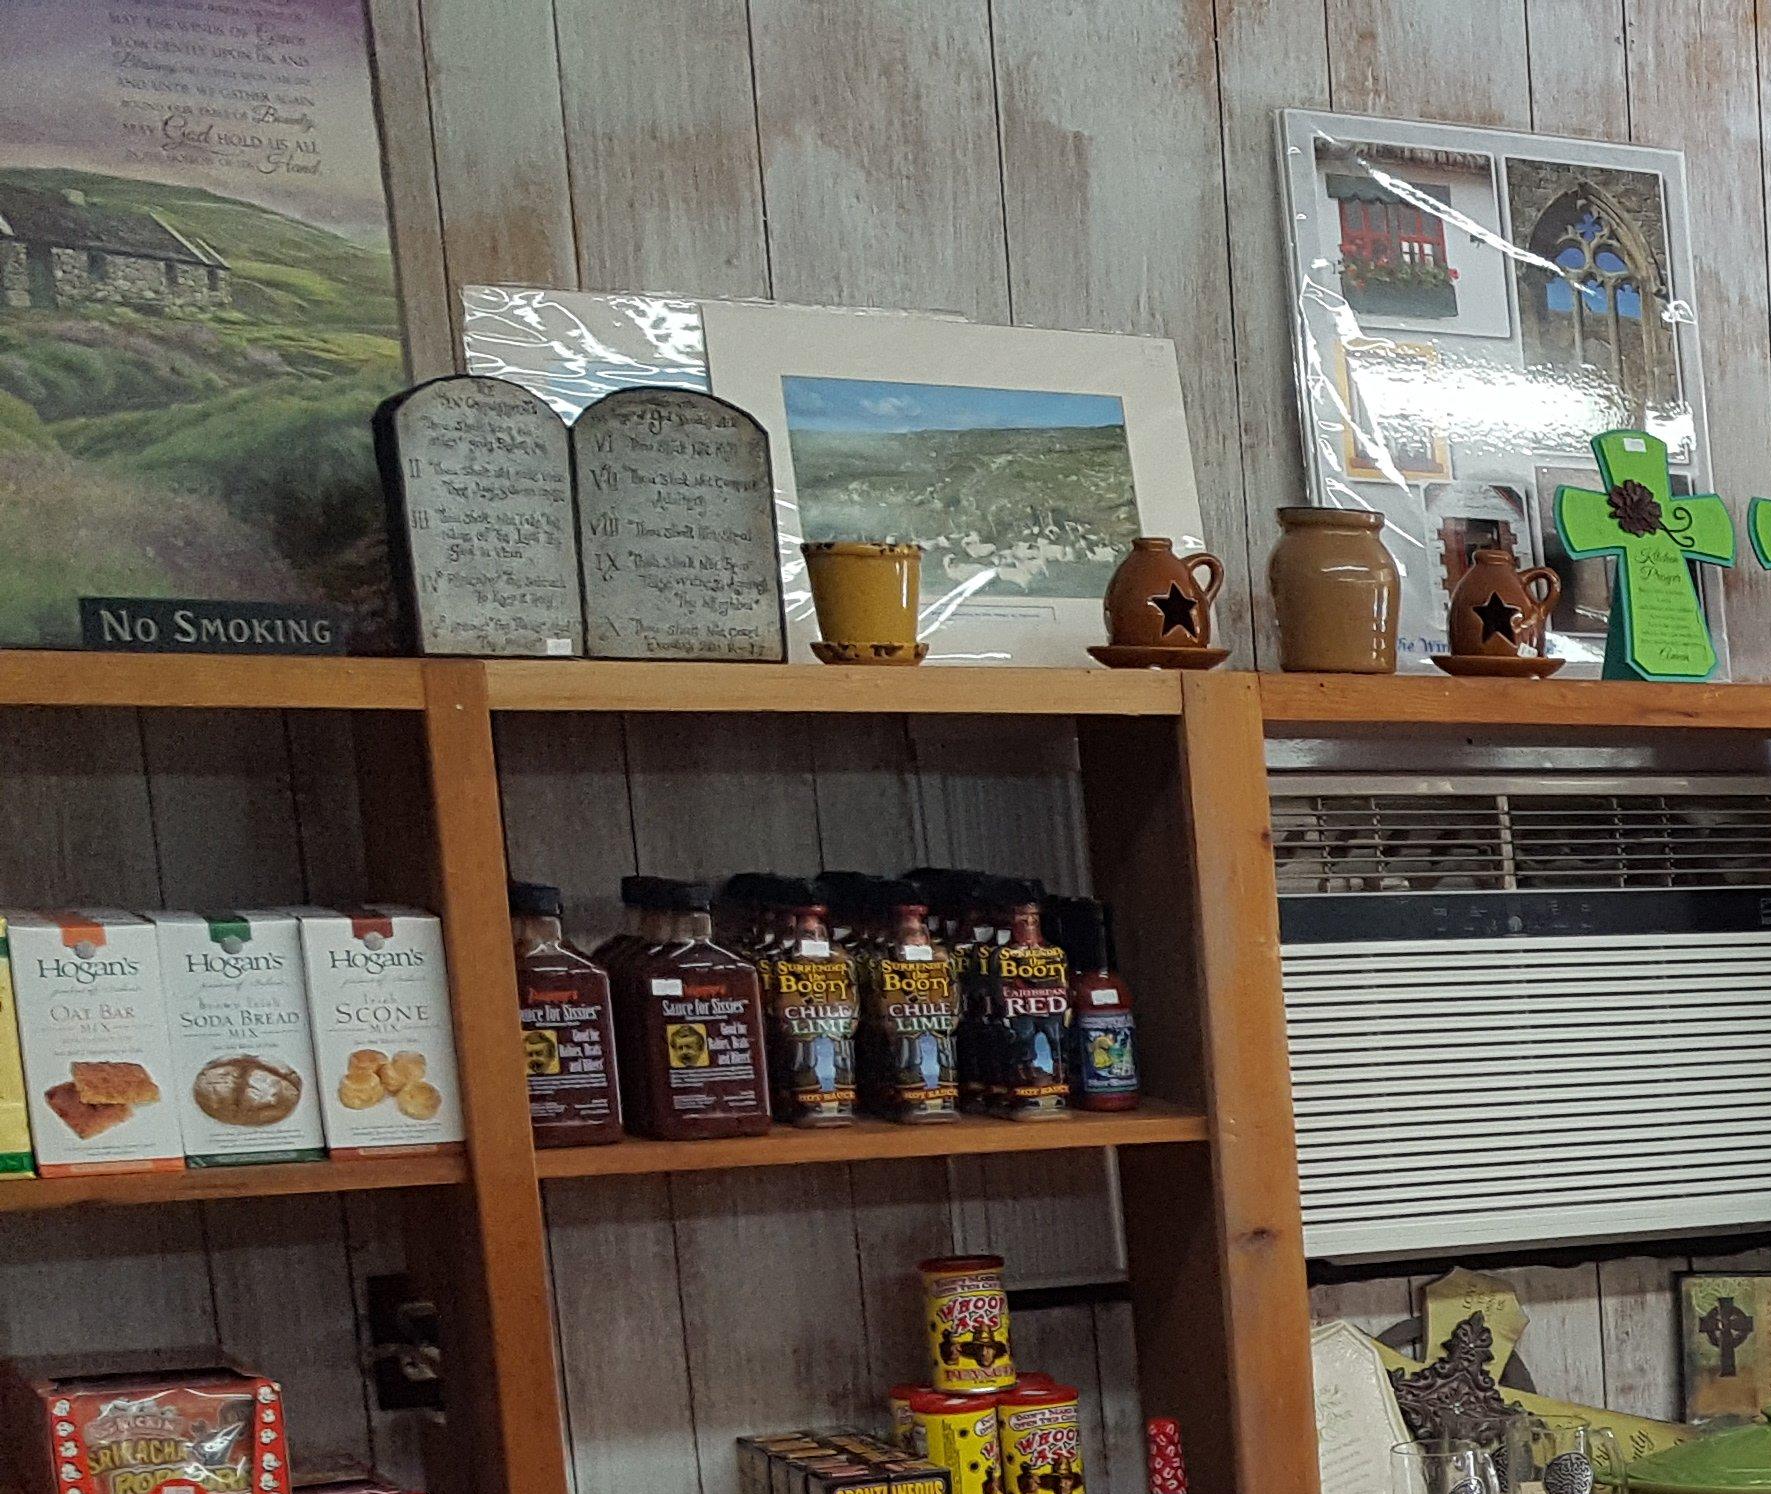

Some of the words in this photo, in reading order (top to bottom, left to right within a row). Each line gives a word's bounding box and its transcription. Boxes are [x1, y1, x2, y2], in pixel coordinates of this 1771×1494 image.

[36, 956, 141, 985] Hogan's
[185, 952, 284, 980] Hogan's
[328, 948, 426, 975] Hogan's
[1001, 957, 1068, 984] BOOTY
[779, 975, 849, 999] BOOTY
[881, 973, 951, 996] BOOTY
[335, 1002, 430, 1025] SCONE
[1006, 995, 1069, 1018] RED
[180, 1012, 234, 1030] SODA
[240, 1009, 300, 1027] BREAD
